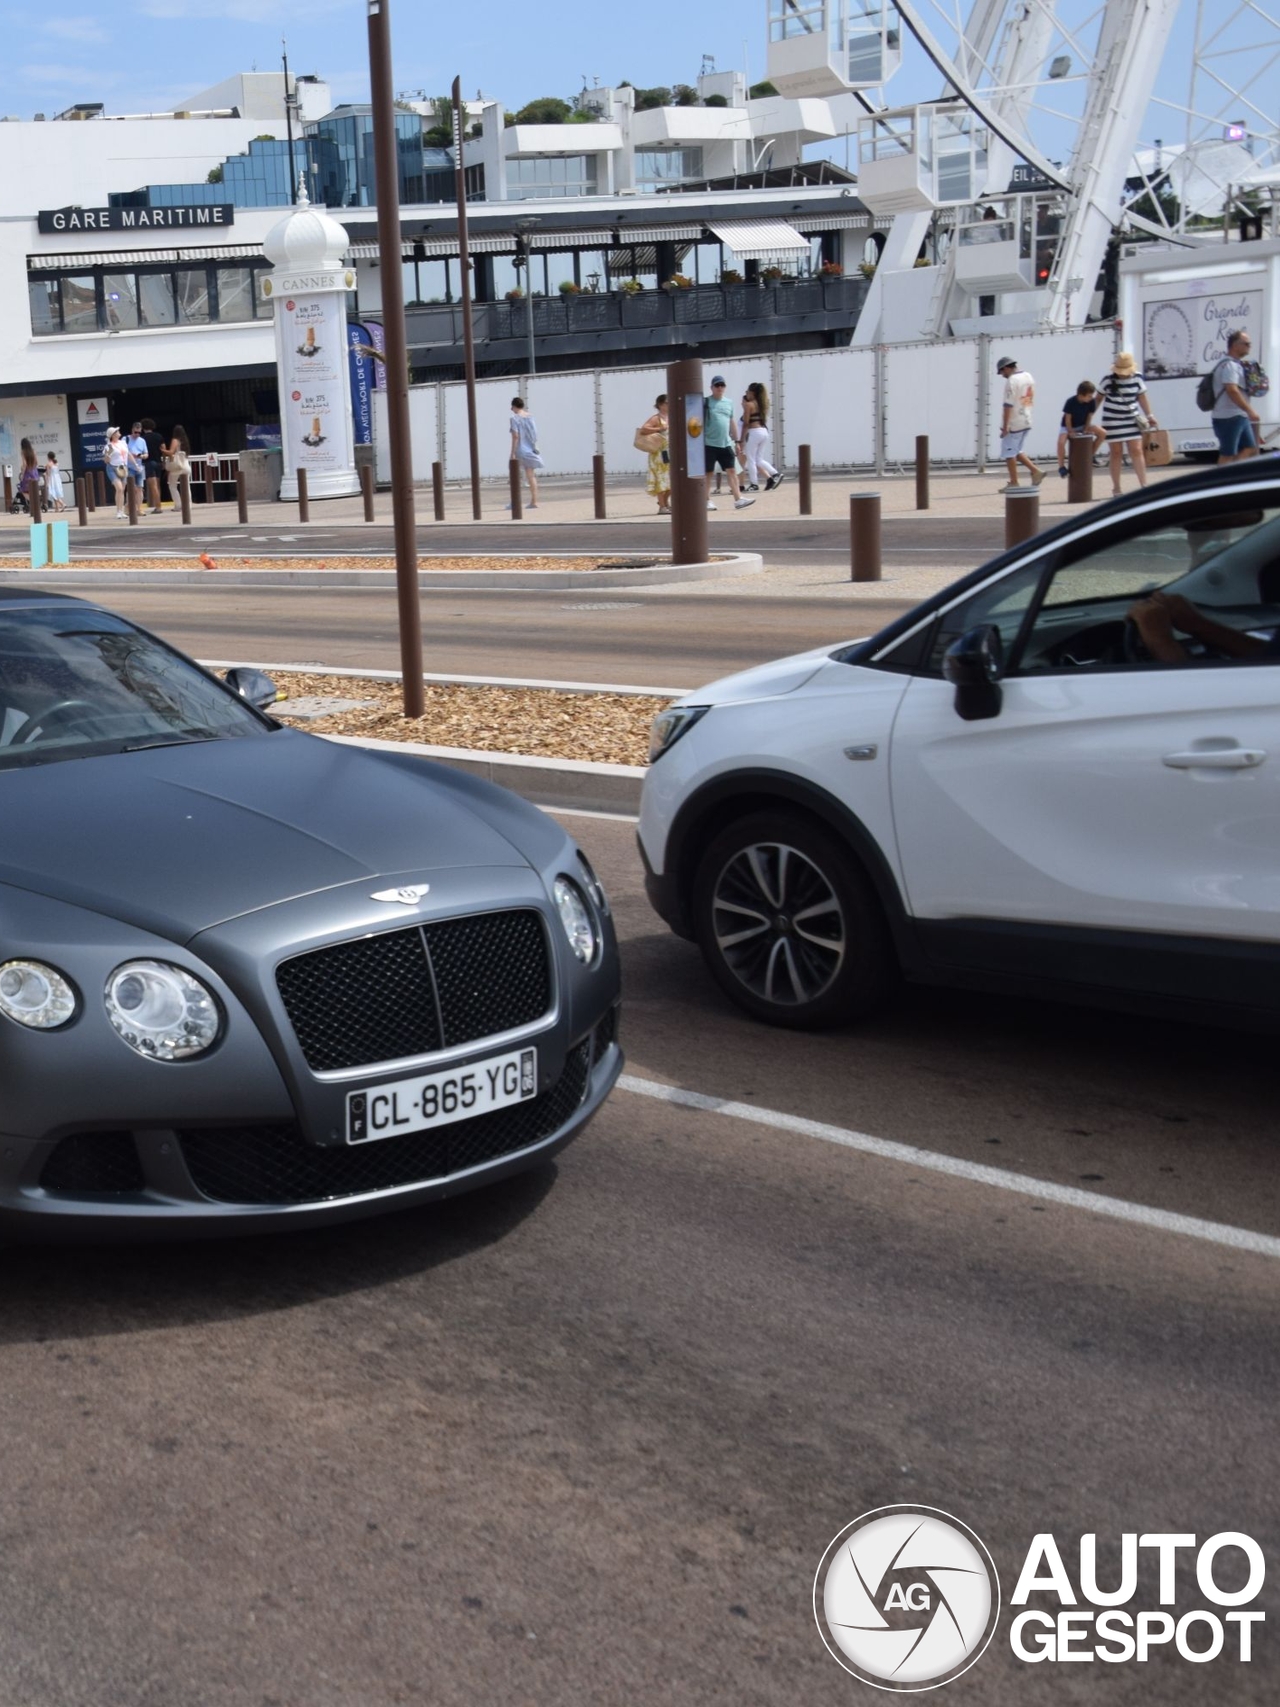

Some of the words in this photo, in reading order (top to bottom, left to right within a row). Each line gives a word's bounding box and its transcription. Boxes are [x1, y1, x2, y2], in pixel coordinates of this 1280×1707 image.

[53, 212, 111, 229] GARE
[122, 207, 223, 227] MARITIME
[282, 276, 336, 291] CANNES
[1204, 296, 1250, 321] Grande
[354, 1119, 362, 1132] F
